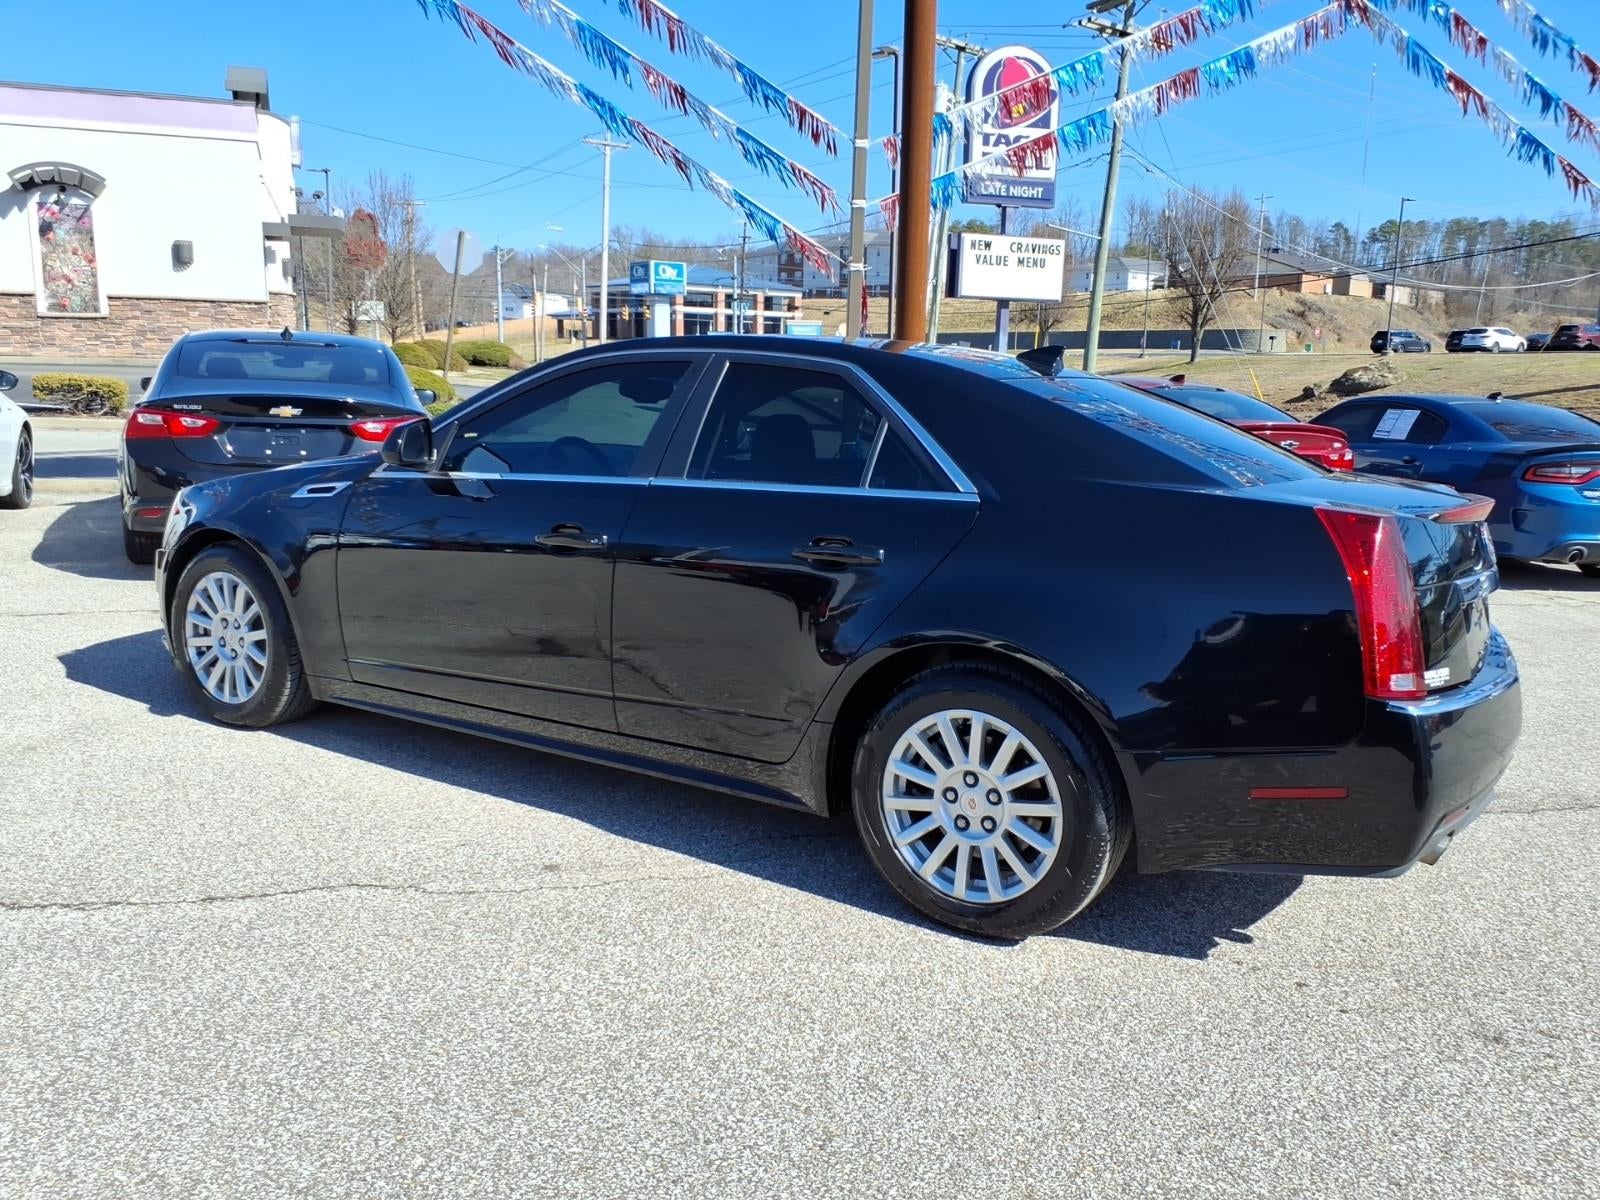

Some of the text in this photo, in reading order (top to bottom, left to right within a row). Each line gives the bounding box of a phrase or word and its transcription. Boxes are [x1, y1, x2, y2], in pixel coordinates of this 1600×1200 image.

[977, 132, 1046, 148] TAC
[981, 183, 1043, 198] LATE NIGHT
[970, 239, 1061, 255] NEW CRAVINGS
[975, 254, 1046, 269] VALUE MENU
